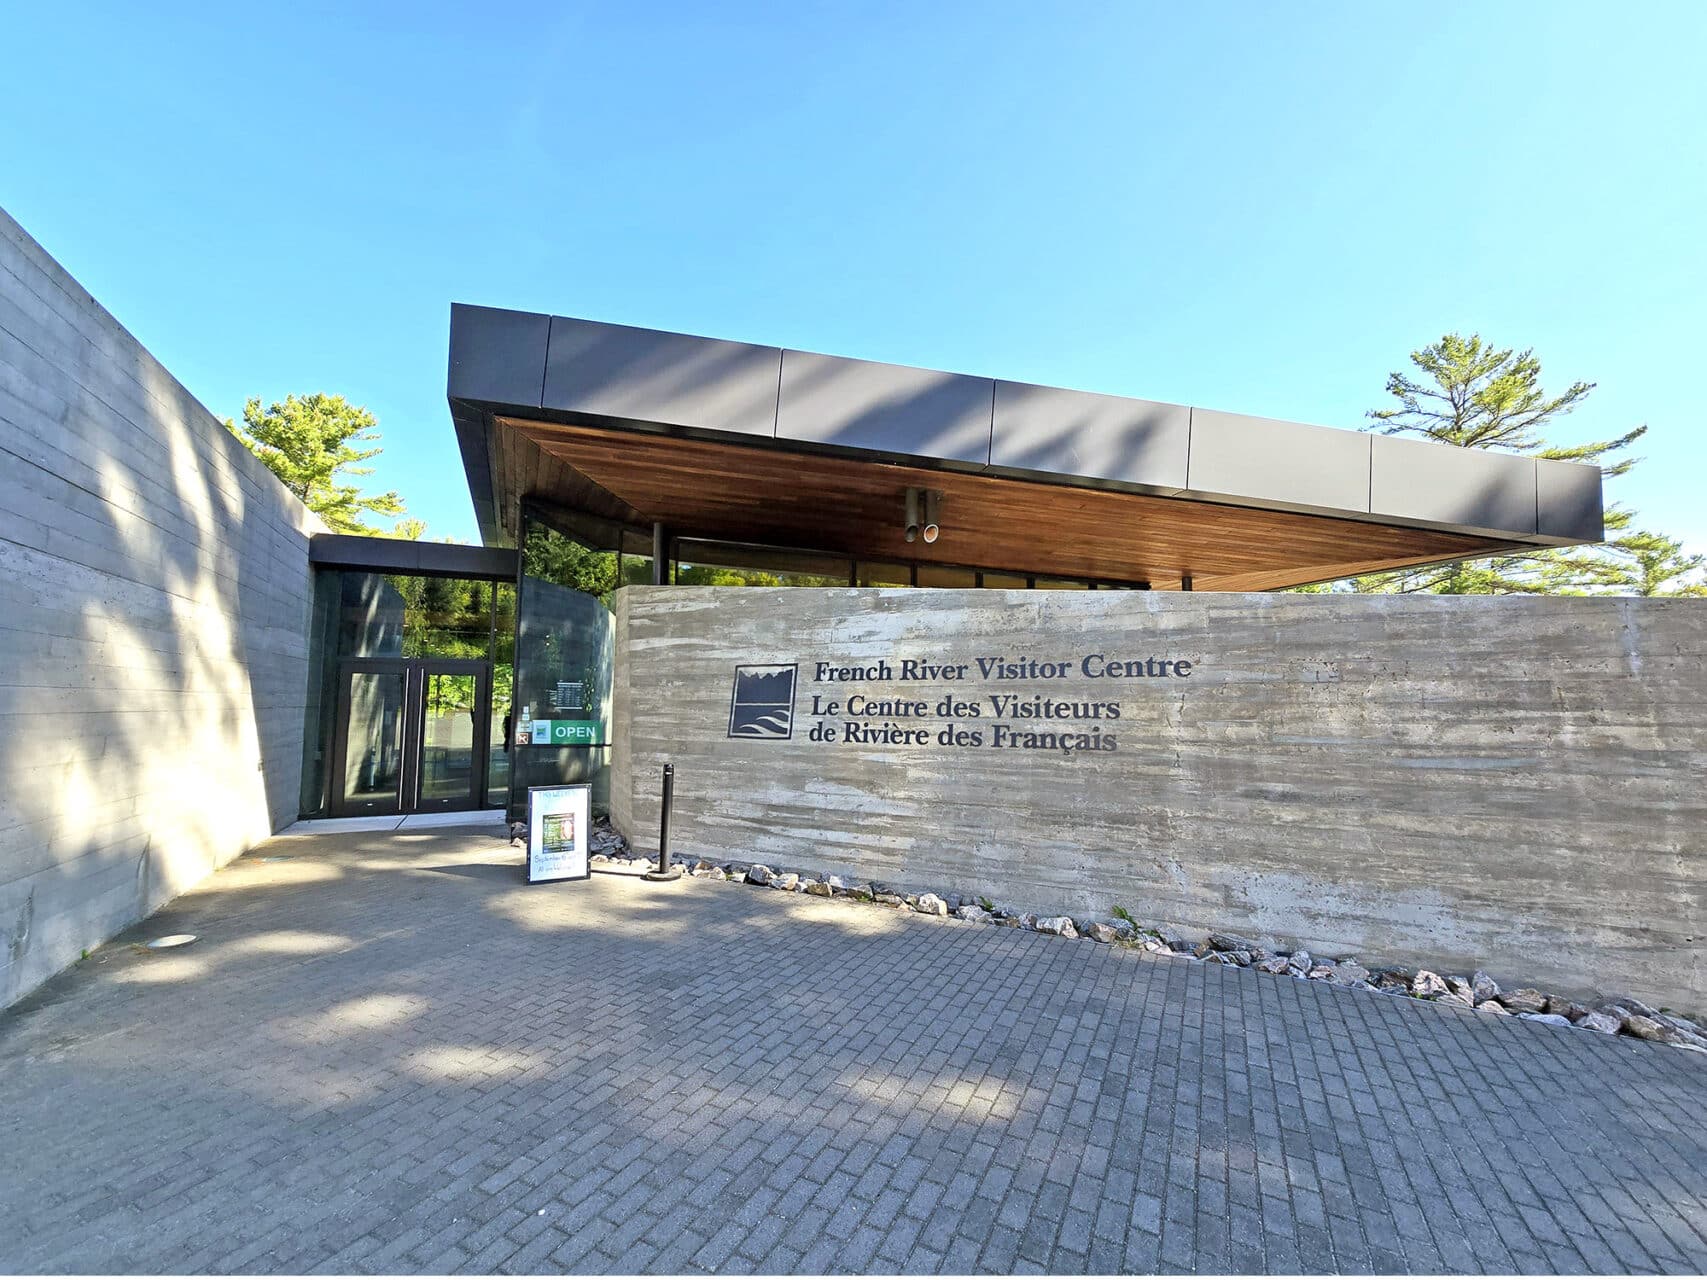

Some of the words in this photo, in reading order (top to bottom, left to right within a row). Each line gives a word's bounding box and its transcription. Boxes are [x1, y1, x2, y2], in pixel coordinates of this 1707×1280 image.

[814, 660, 892, 682] French
[901, 660, 968, 681] River
[975, 657, 1073, 679] Visitor
[1081, 654, 1192, 678] Centre
[810, 695, 839, 716] Le
[847, 695, 927, 718] Centre
[936, 694, 980, 718] des
[989, 694, 1120, 720] Visiteurs
[556, 727, 596, 737] OPEN
[809, 721, 836, 743] de
[843, 721, 930, 746] Rivière
[938, 725, 982, 747] des
[990, 725, 1118, 755] Français
